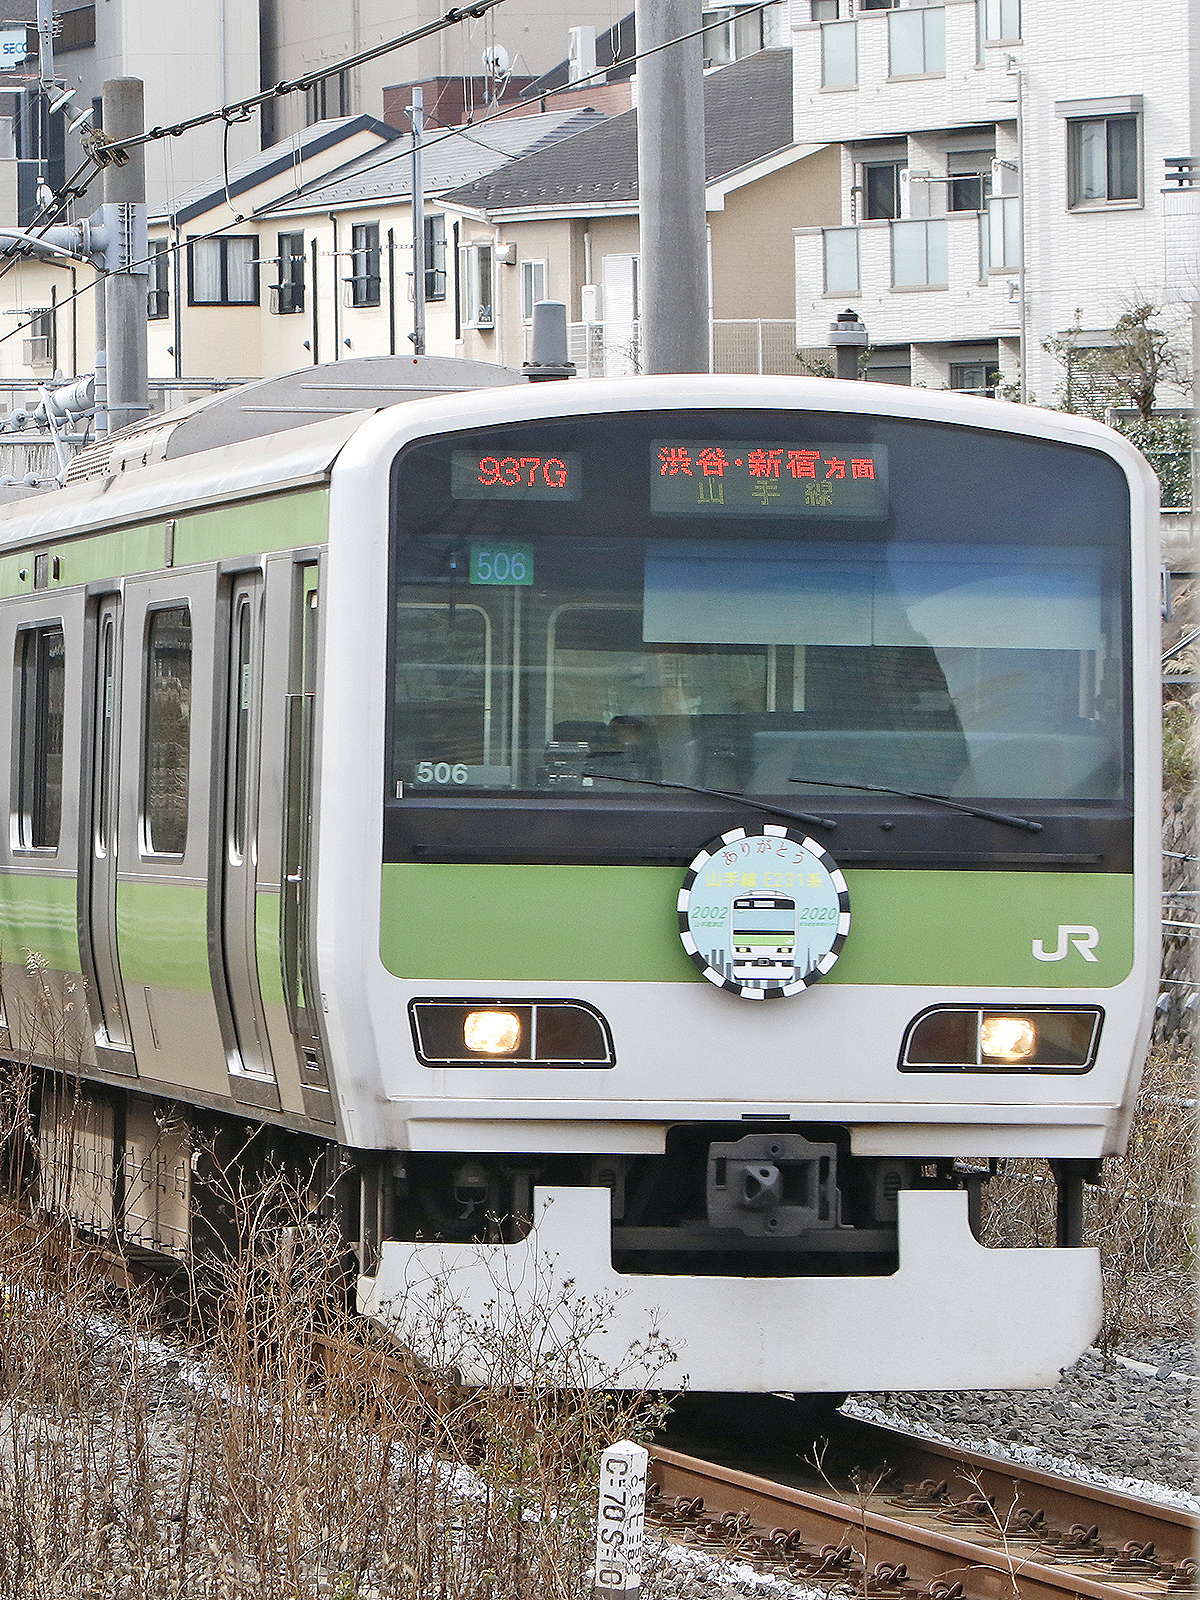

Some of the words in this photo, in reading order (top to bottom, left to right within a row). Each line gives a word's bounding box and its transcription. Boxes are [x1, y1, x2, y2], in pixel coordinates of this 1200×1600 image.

[477, 456, 568, 488] 937G
[697, 477, 833, 506] 山手線
[477, 551, 526, 581] 506
[417, 761, 468, 785] 506
[721, 839, 805, 867] ありがとう
[691, 906, 728, 919] 2002
[800, 907, 837, 920] 2020
[1031, 925, 1099, 962] JR
